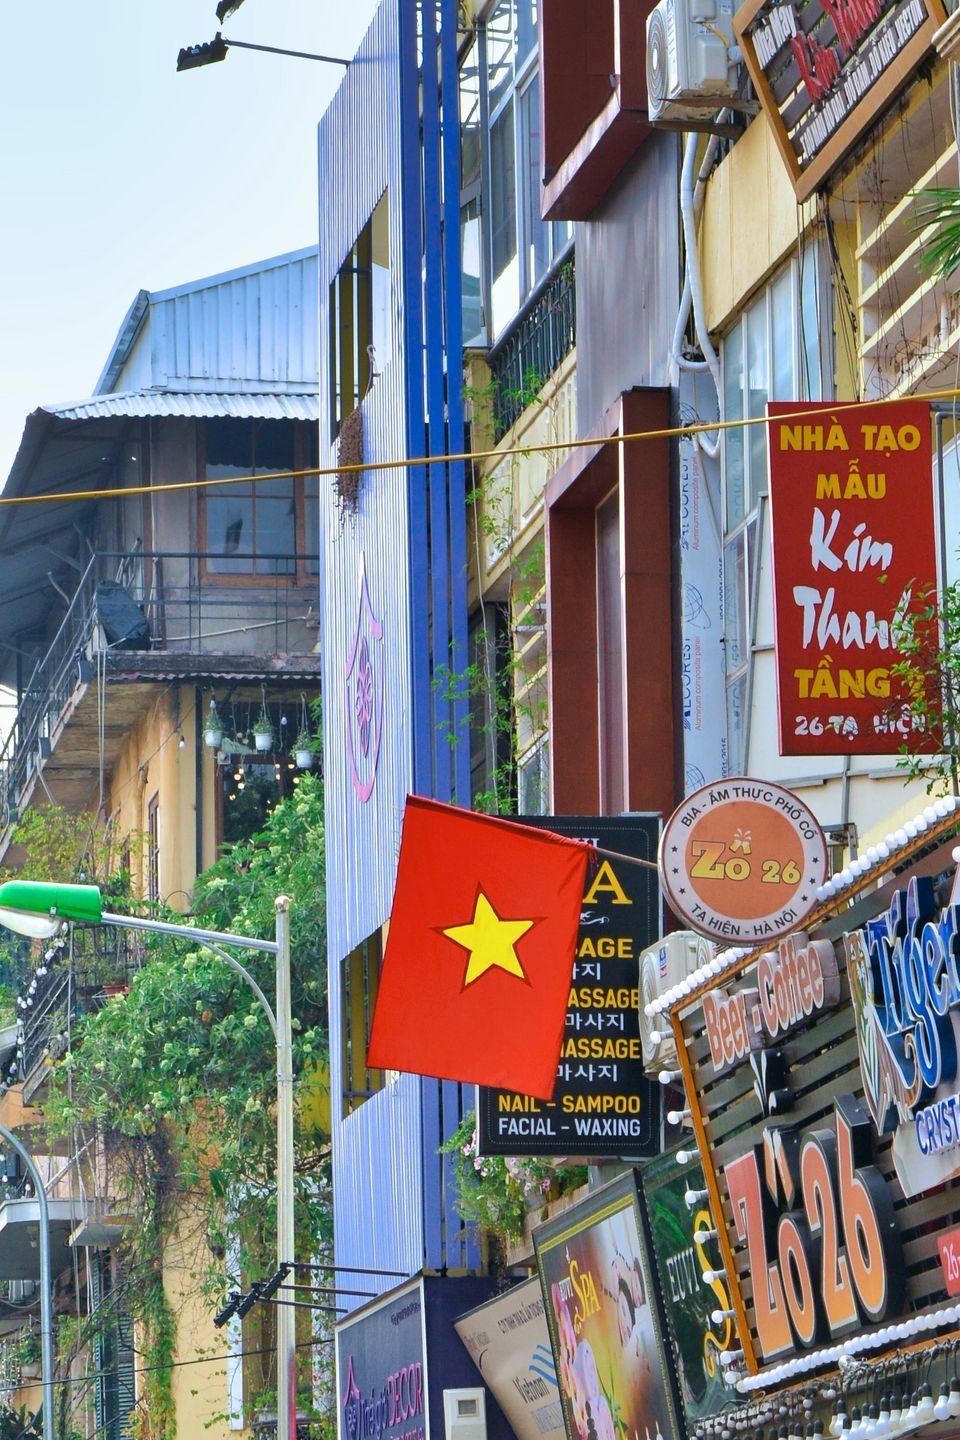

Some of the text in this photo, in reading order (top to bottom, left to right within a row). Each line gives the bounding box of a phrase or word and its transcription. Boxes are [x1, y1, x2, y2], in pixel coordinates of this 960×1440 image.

[780, 416, 921, 457] NHÀ TẠO
[815, 458, 887, 500] MẪU
[809, 506, 894, 573] Kim
[793, 655, 891, 699] TẦNG
[794, 715, 824, 736] 26
[681, 806, 702, 828] BIA
[732, 786, 773, 802] THỰC
[774, 796, 806, 820] PHỐ
[761, 858, 802, 885] 26
[691, 903, 706, 921] TẠ
[708, 918, 741, 937] HIỆN
[753, 921, 774, 937] HÀ
[775, 908, 798, 929] NỘI
[569, 989, 639, 1008] ASSAGE
[703, 987, 751, 1073] Beer
[757, 940, 825, 1038] Coffee
[560, 1039, 641, 1058] ASSAGE
[499, 1095, 541, 1113] NAIL
[562, 1095, 641, 1113] SAMPOO
[499, 1118, 556, 1136] FACIAL
[575, 1118, 641, 1136] WAXING
[943, 1243, 959, 1281] 26
[570, 1260, 601, 1334] SPA
[388, 1362, 423, 1429] DECOR
